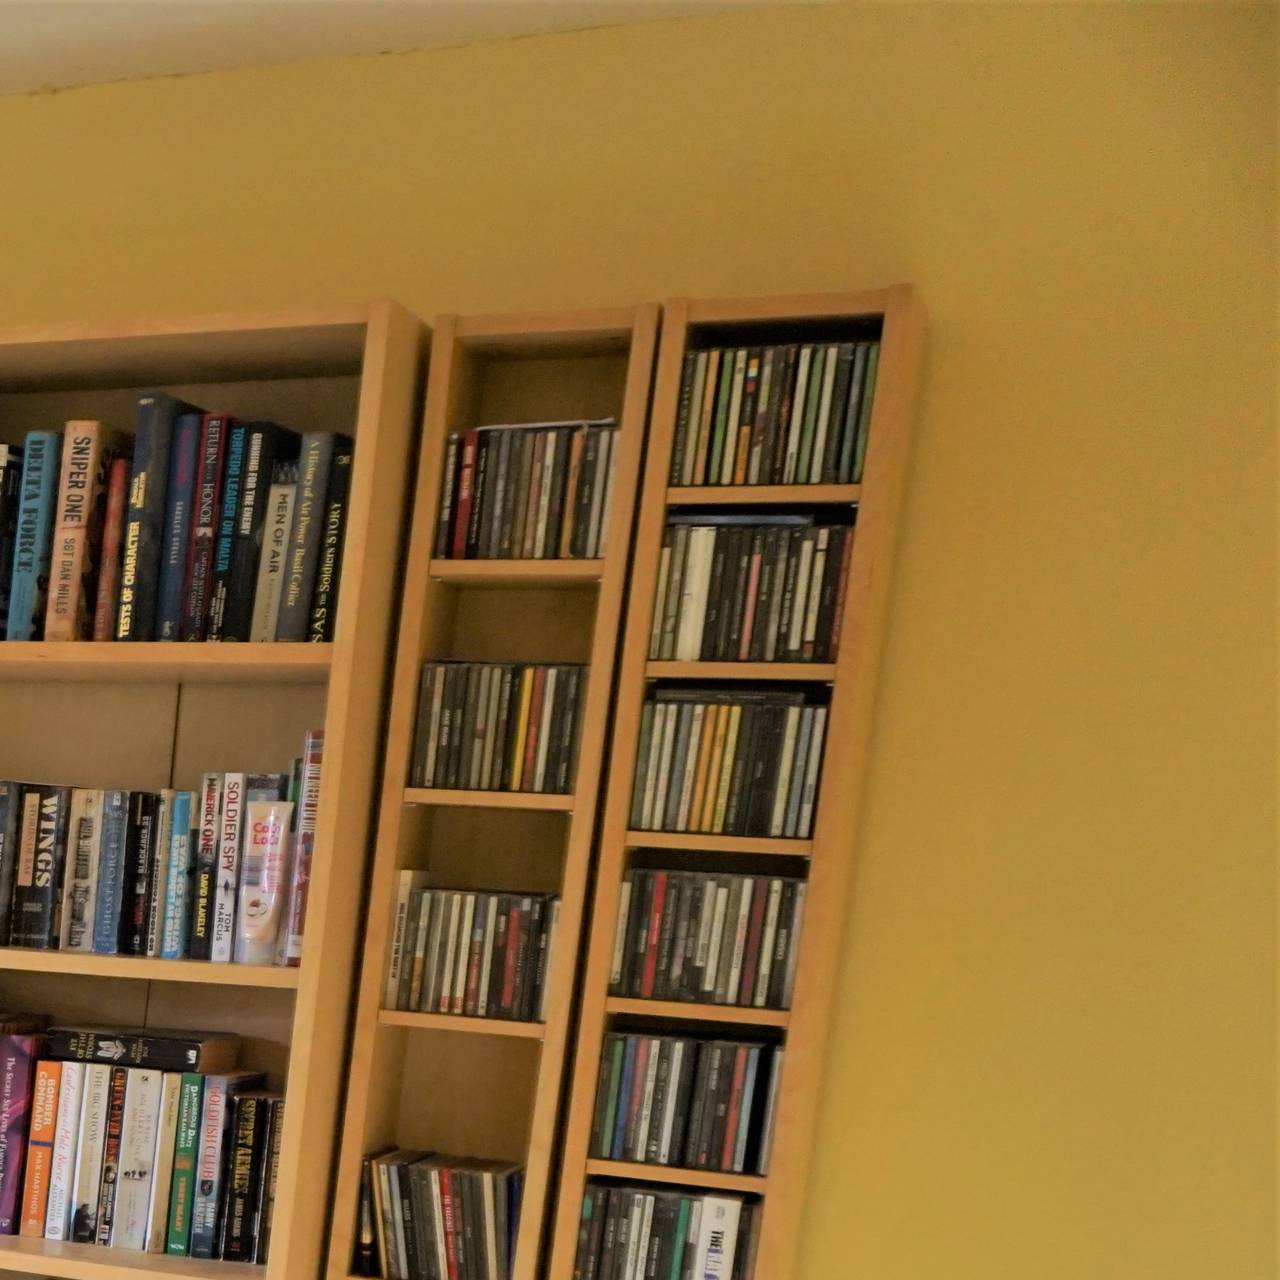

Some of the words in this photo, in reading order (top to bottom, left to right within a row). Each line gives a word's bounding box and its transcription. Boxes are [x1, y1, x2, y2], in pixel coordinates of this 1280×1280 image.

[68, 436, 91, 489] SNIPER
[228, 428, 245, 475] TORPEDO
[24, 439, 46, 501] DELTA
[63, 494, 84, 523] ONE
[223, 478, 240, 518] LEADER
[276, 494, 289, 525] MEN
[17, 508, 42, 573] FORCE
[222, 520, 235, 535] ON
[273, 528, 285, 547] OF
[60, 560, 74, 581] DAN
[216, 538, 232, 571] MALTA
[268, 550, 281, 574] AIR
[55, 583, 71, 615] MILLS
[205, 778, 217, 826] MAVERICK
[224, 782, 240, 842] SOLDIER
[35, 795, 58, 888] WINGS
[201, 829, 213, 855] ONE
[222, 847, 235, 873] SPY
[200, 874, 209, 896] DAVID
[196, 898, 207, 938] BLAKELEY
[215, 903, 224, 941] MARCUS
[33, 1071, 48, 1131] COMMAND
[44, 1078, 56, 1125] BOMBER
[711, 1230, 724, 1249] THE
